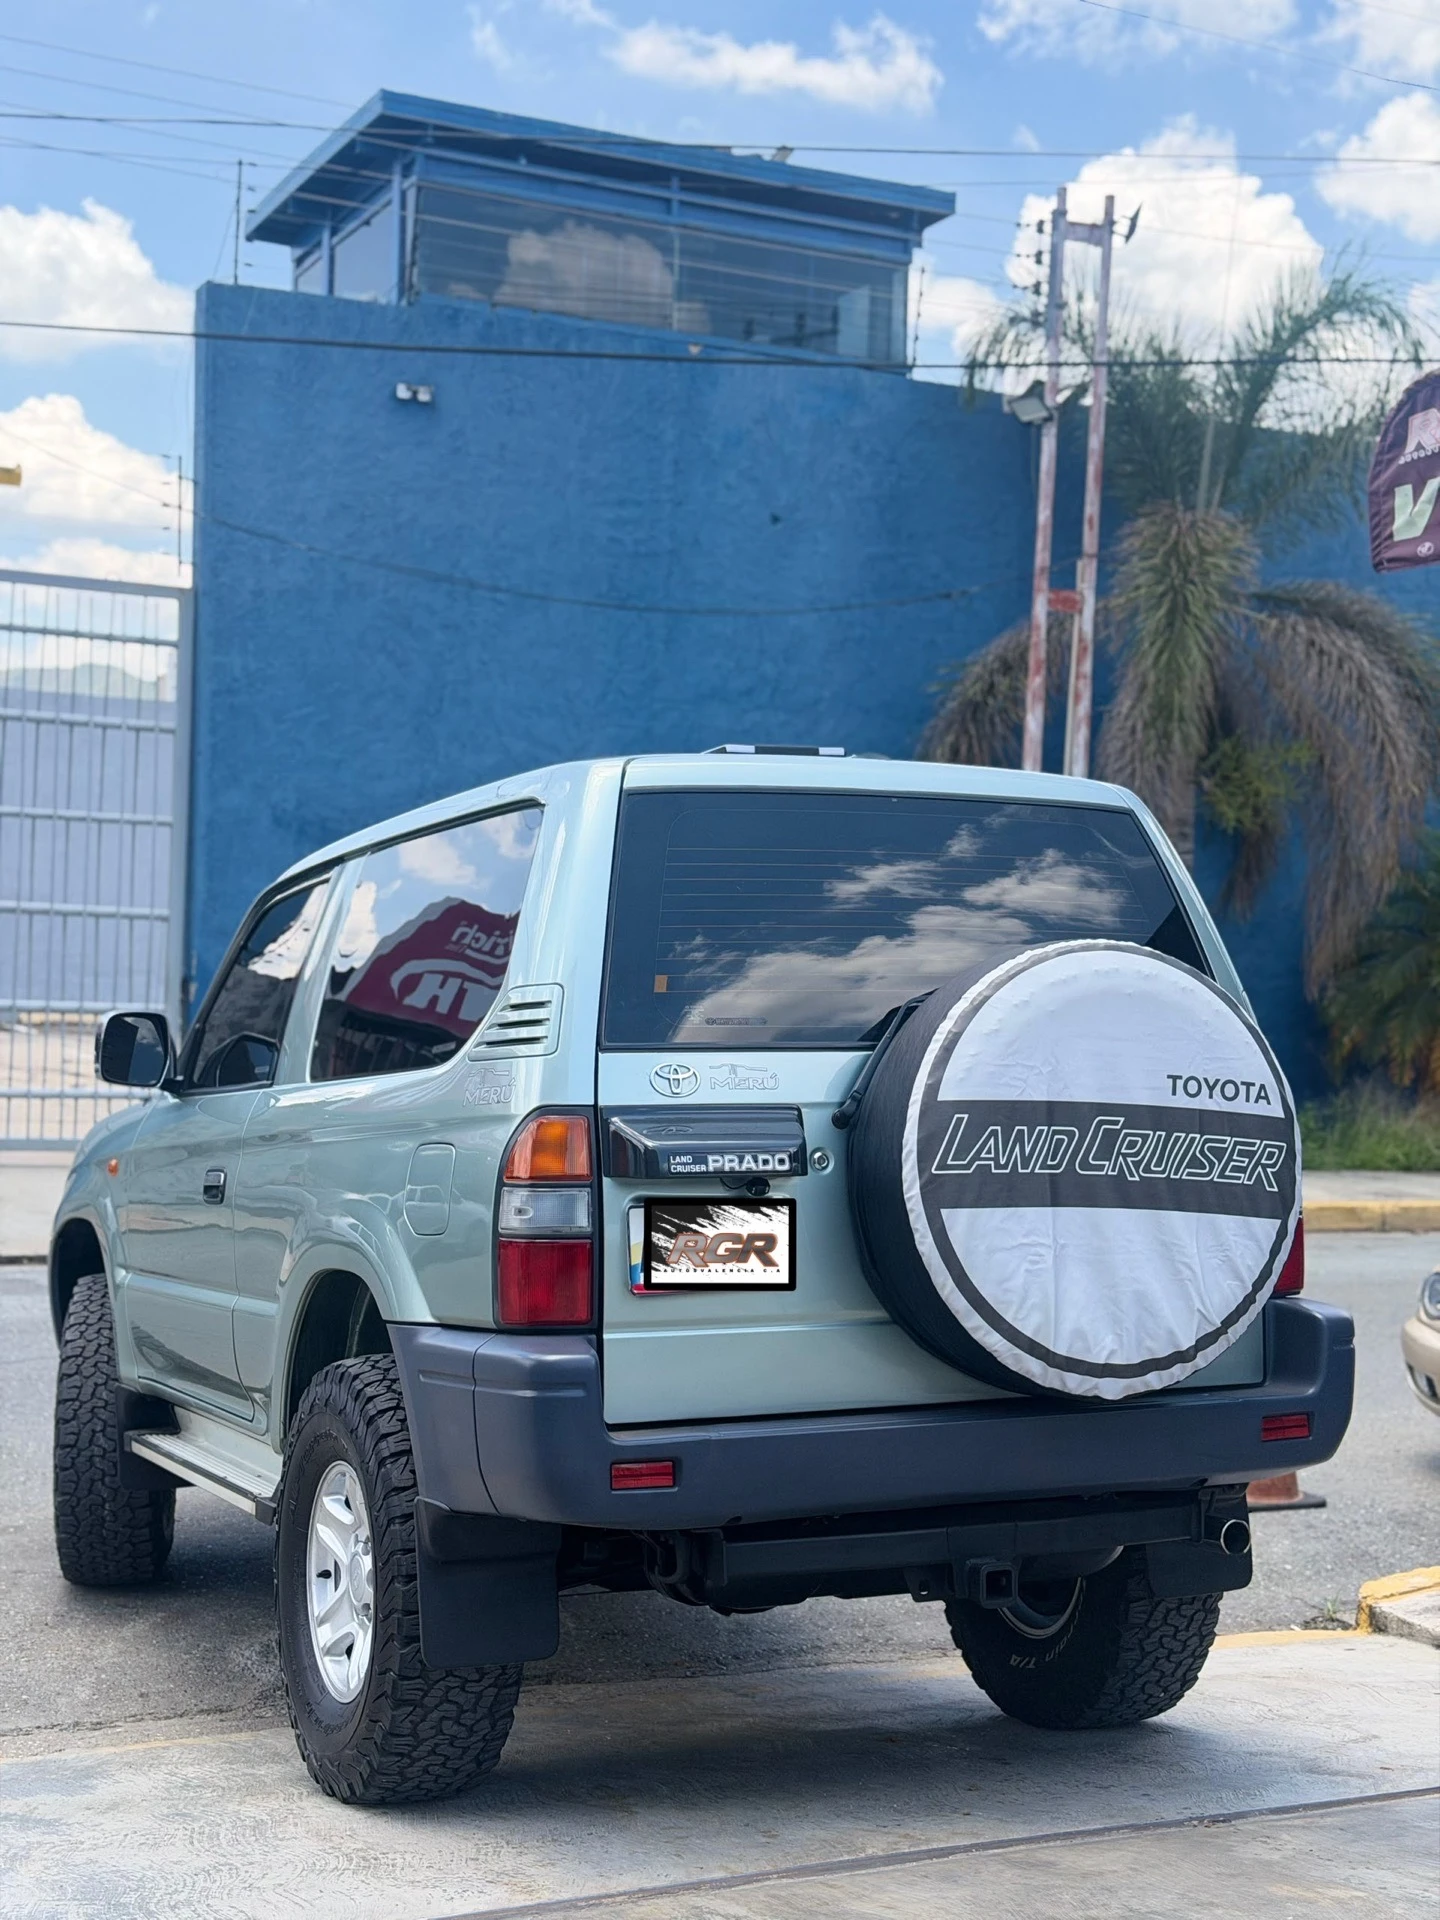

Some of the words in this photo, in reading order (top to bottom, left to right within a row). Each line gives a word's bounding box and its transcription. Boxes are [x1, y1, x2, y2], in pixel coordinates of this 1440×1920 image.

[709, 1072, 780, 1090] MERÚ
[1166, 1074, 1272, 1106] TOYOTA
[670, 1155, 693, 1163] LAND
[931, 1114, 1080, 1174] LAND
[1075, 1116, 1288, 1192] CRUISER
[670, 1164, 707, 1173] CRUISER
[707, 1153, 791, 1172] PRADO
